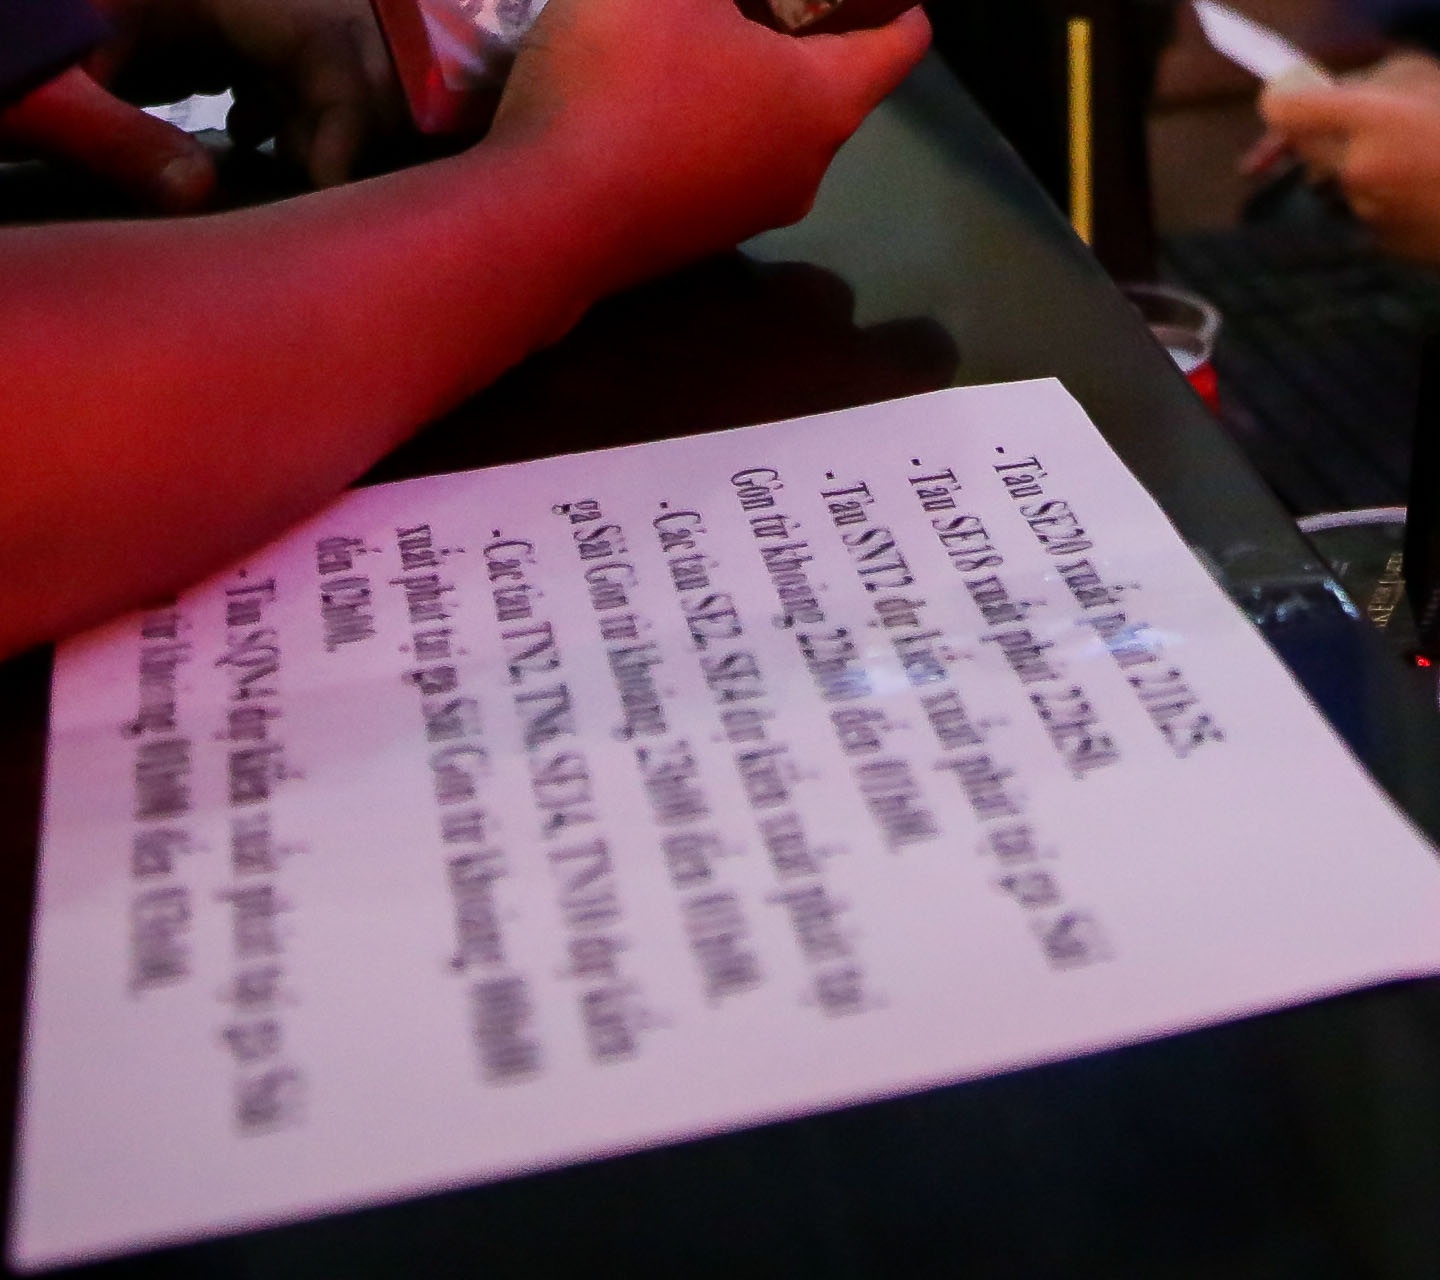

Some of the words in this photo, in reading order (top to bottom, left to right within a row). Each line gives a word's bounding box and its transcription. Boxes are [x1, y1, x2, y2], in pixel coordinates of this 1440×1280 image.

[907, 467, 962, 512] Tàu
[993, 455, 1048, 499] Tàu
[550, 498, 603, 524] ga
[820, 480, 875, 527] Tàu
[1019, 499, 1093, 555] SE20
[395, 523, 465, 571] xuất
[482, 538, 537, 582] Các
[572, 523, 628, 560] Sài
[729, 466, 784, 511] Gòn
[760, 539, 826, 629] khoảng
[840, 526, 915, 592] SNT2
[930, 514, 1004, 572] SE18
[388, 572, 458, 624] phát
[583, 561, 638, 611] Gòn
[651, 509, 706, 552] Các
[698, 650, 764, 705] SE4
[963, 574, 1046, 626] xuất
[1055, 557, 1140, 609] xuất
